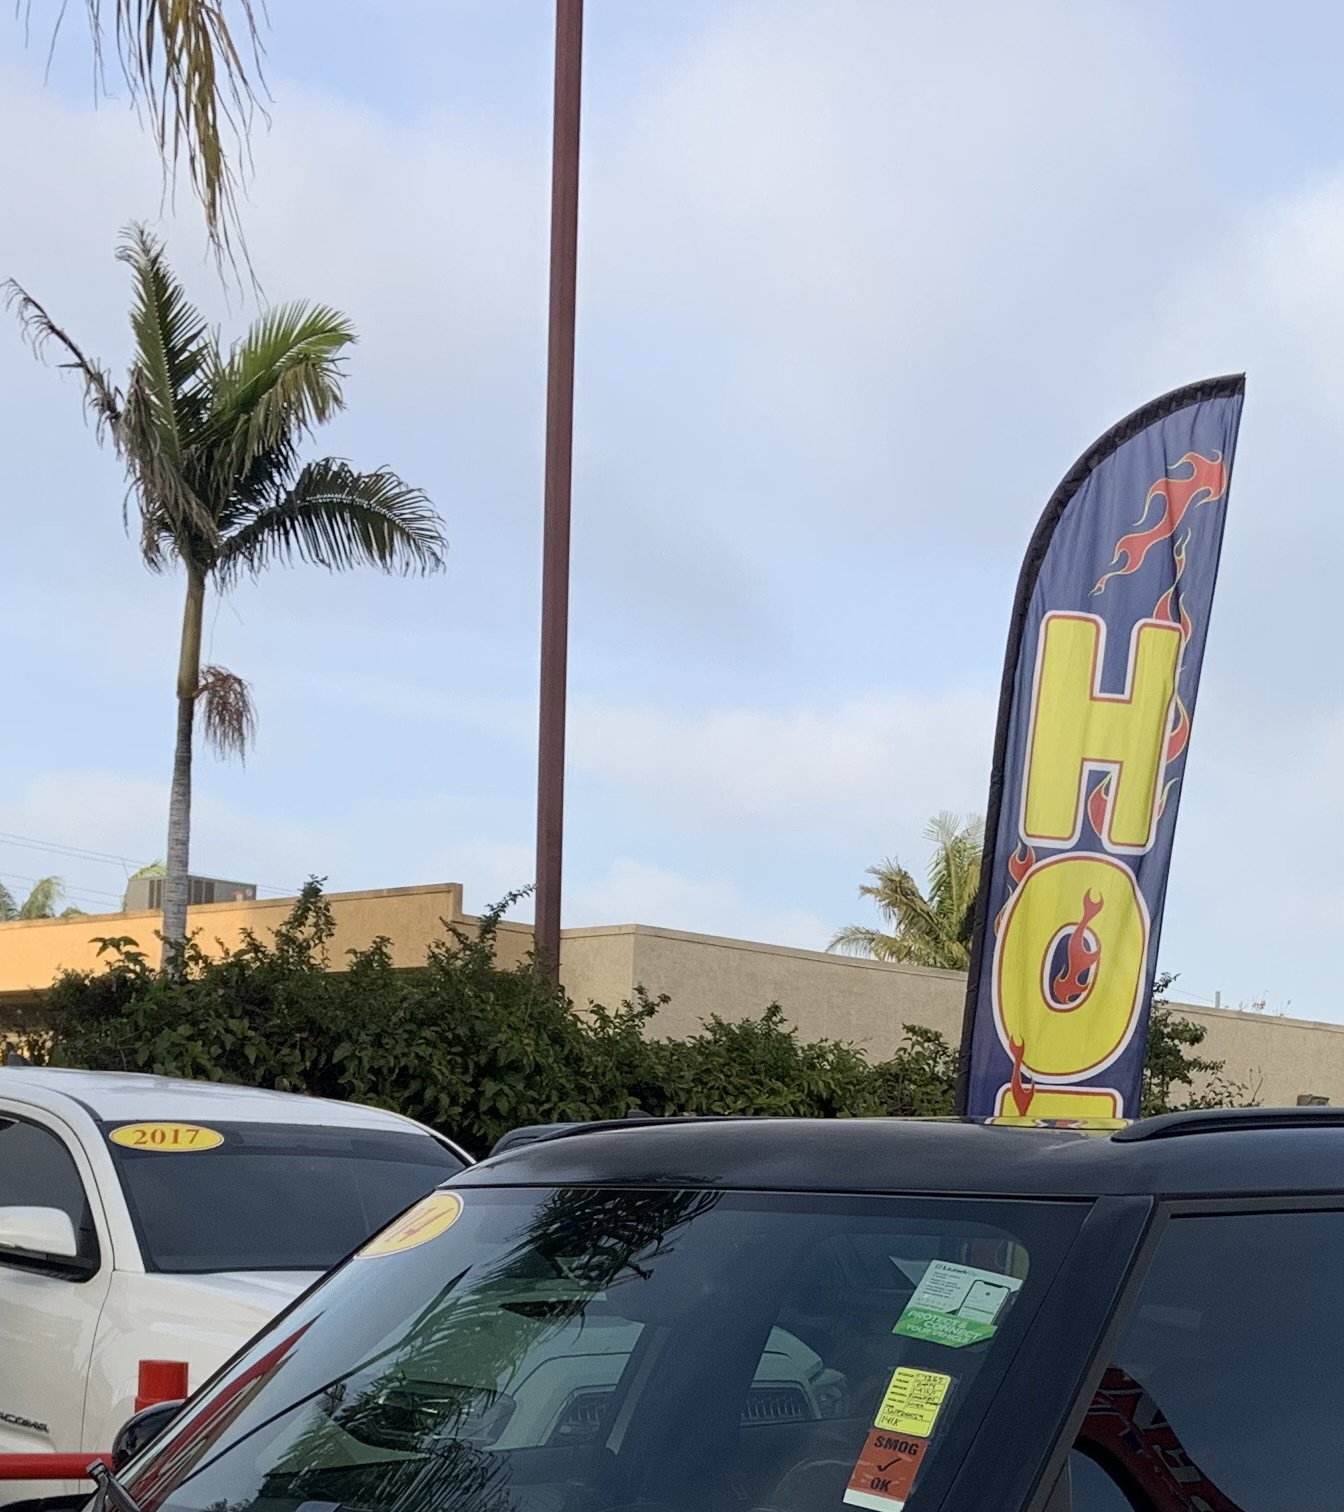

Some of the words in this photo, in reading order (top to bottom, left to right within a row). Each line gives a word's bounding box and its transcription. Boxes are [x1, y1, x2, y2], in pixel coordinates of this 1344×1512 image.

[992, 610, 1184, 1118] HO
[132, 1128, 200, 1146] 2017
[924, 1320, 982, 1341] CONNECT
[873, 1435, 919, 1456] SMOG
[869, 1476, 892, 1492] OK
